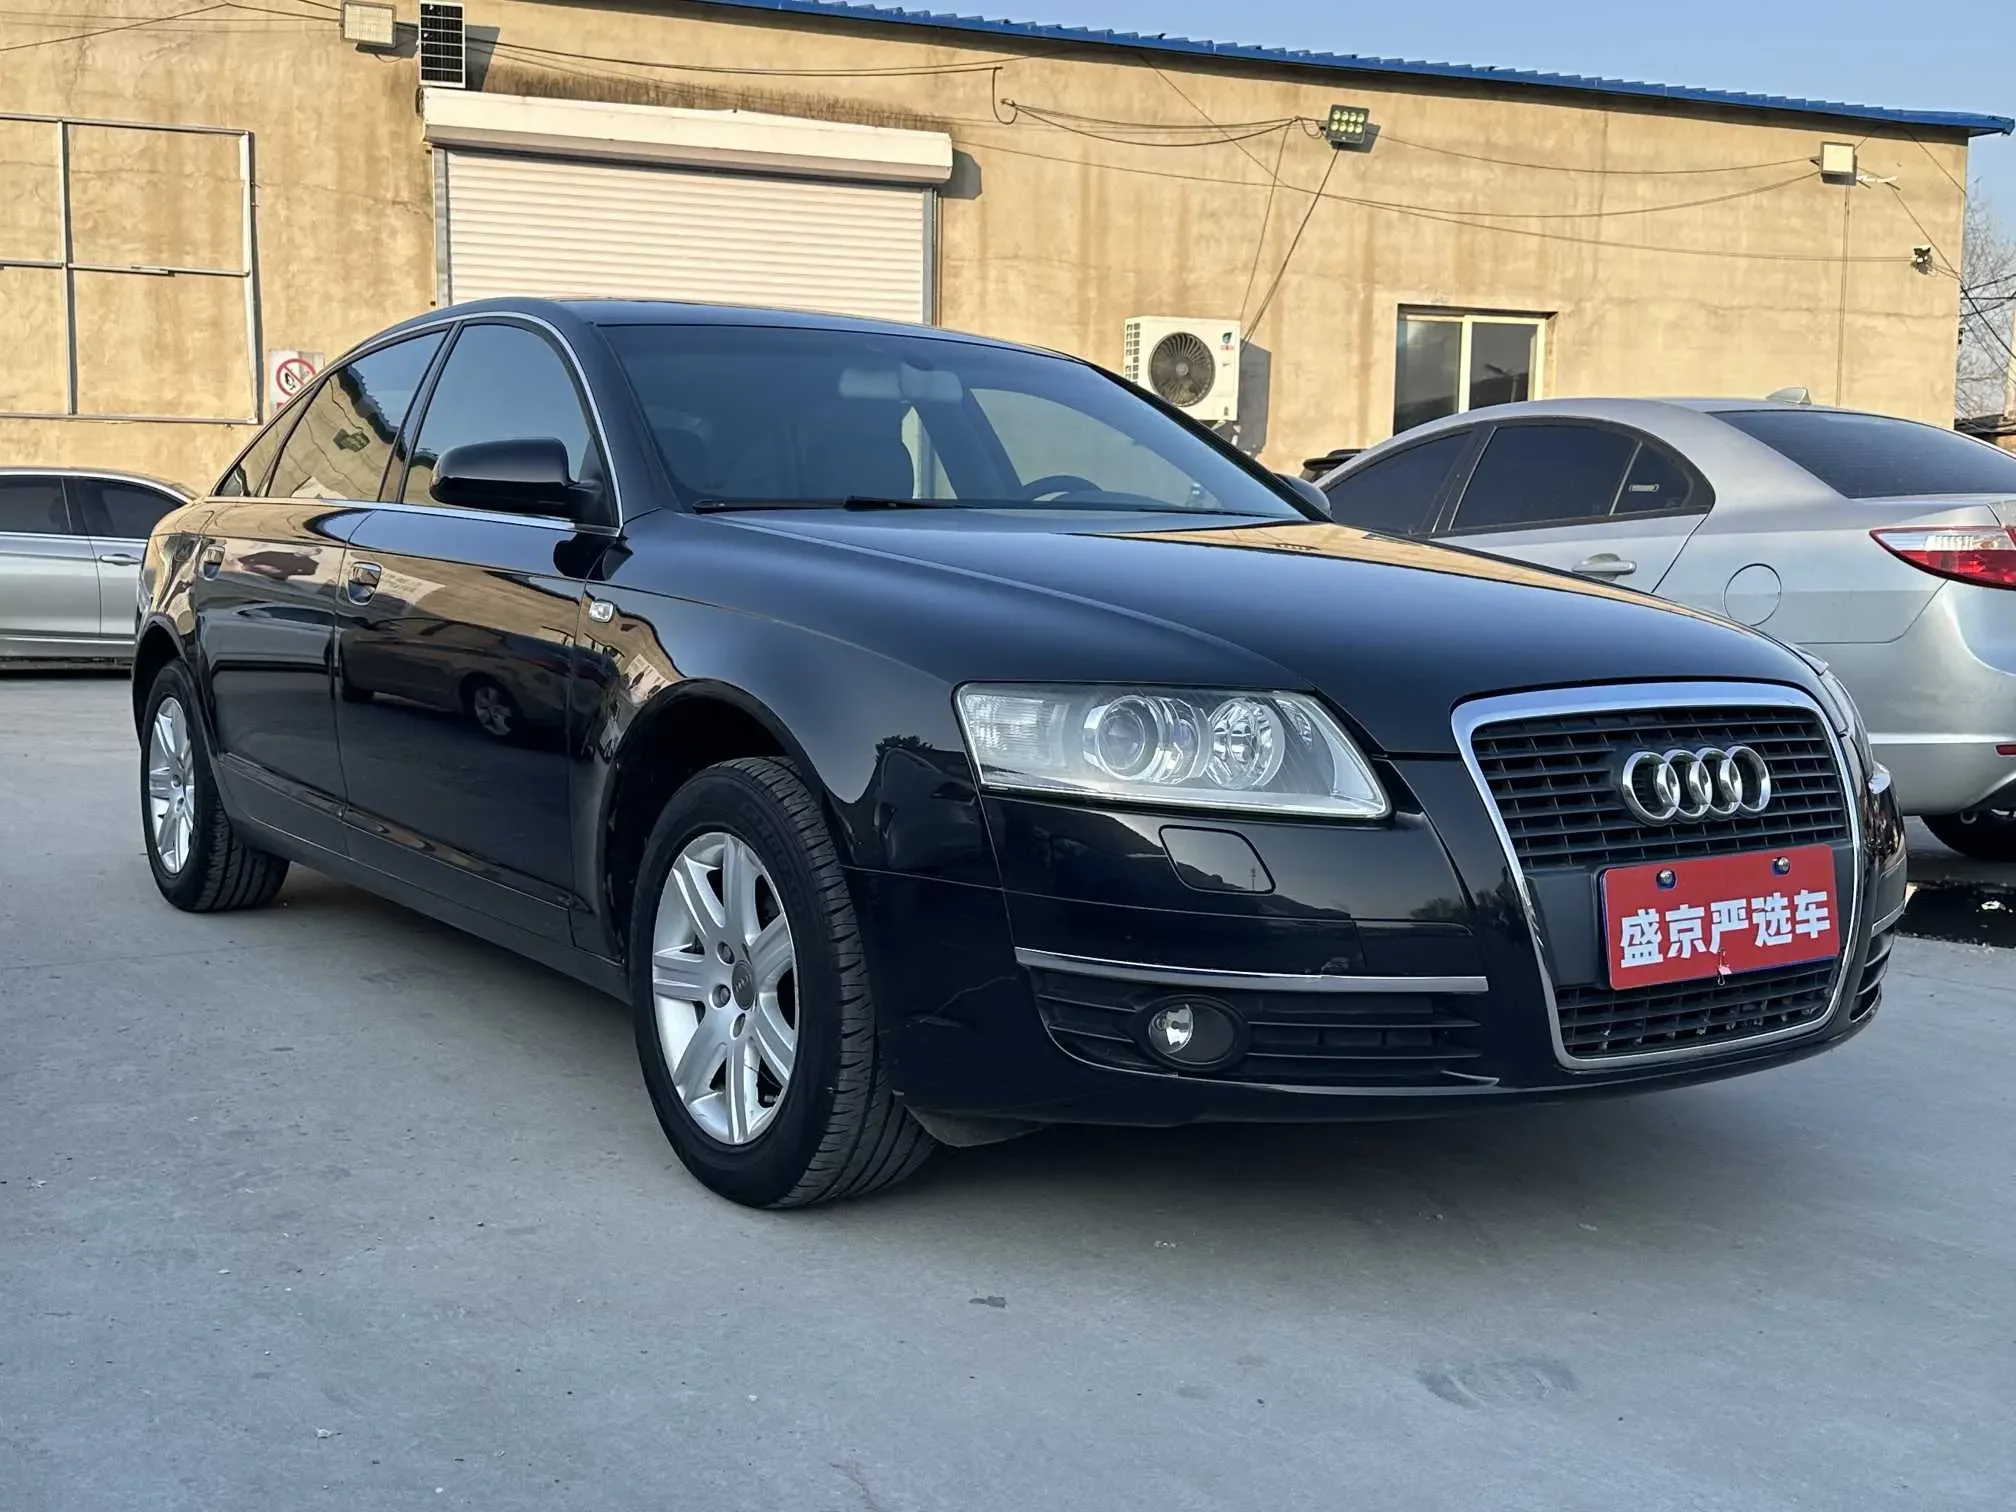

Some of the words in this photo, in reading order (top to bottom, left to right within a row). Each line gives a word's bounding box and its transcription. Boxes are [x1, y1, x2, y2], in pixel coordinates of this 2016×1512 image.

[1620, 889, 1831, 968] 盛京严选车
